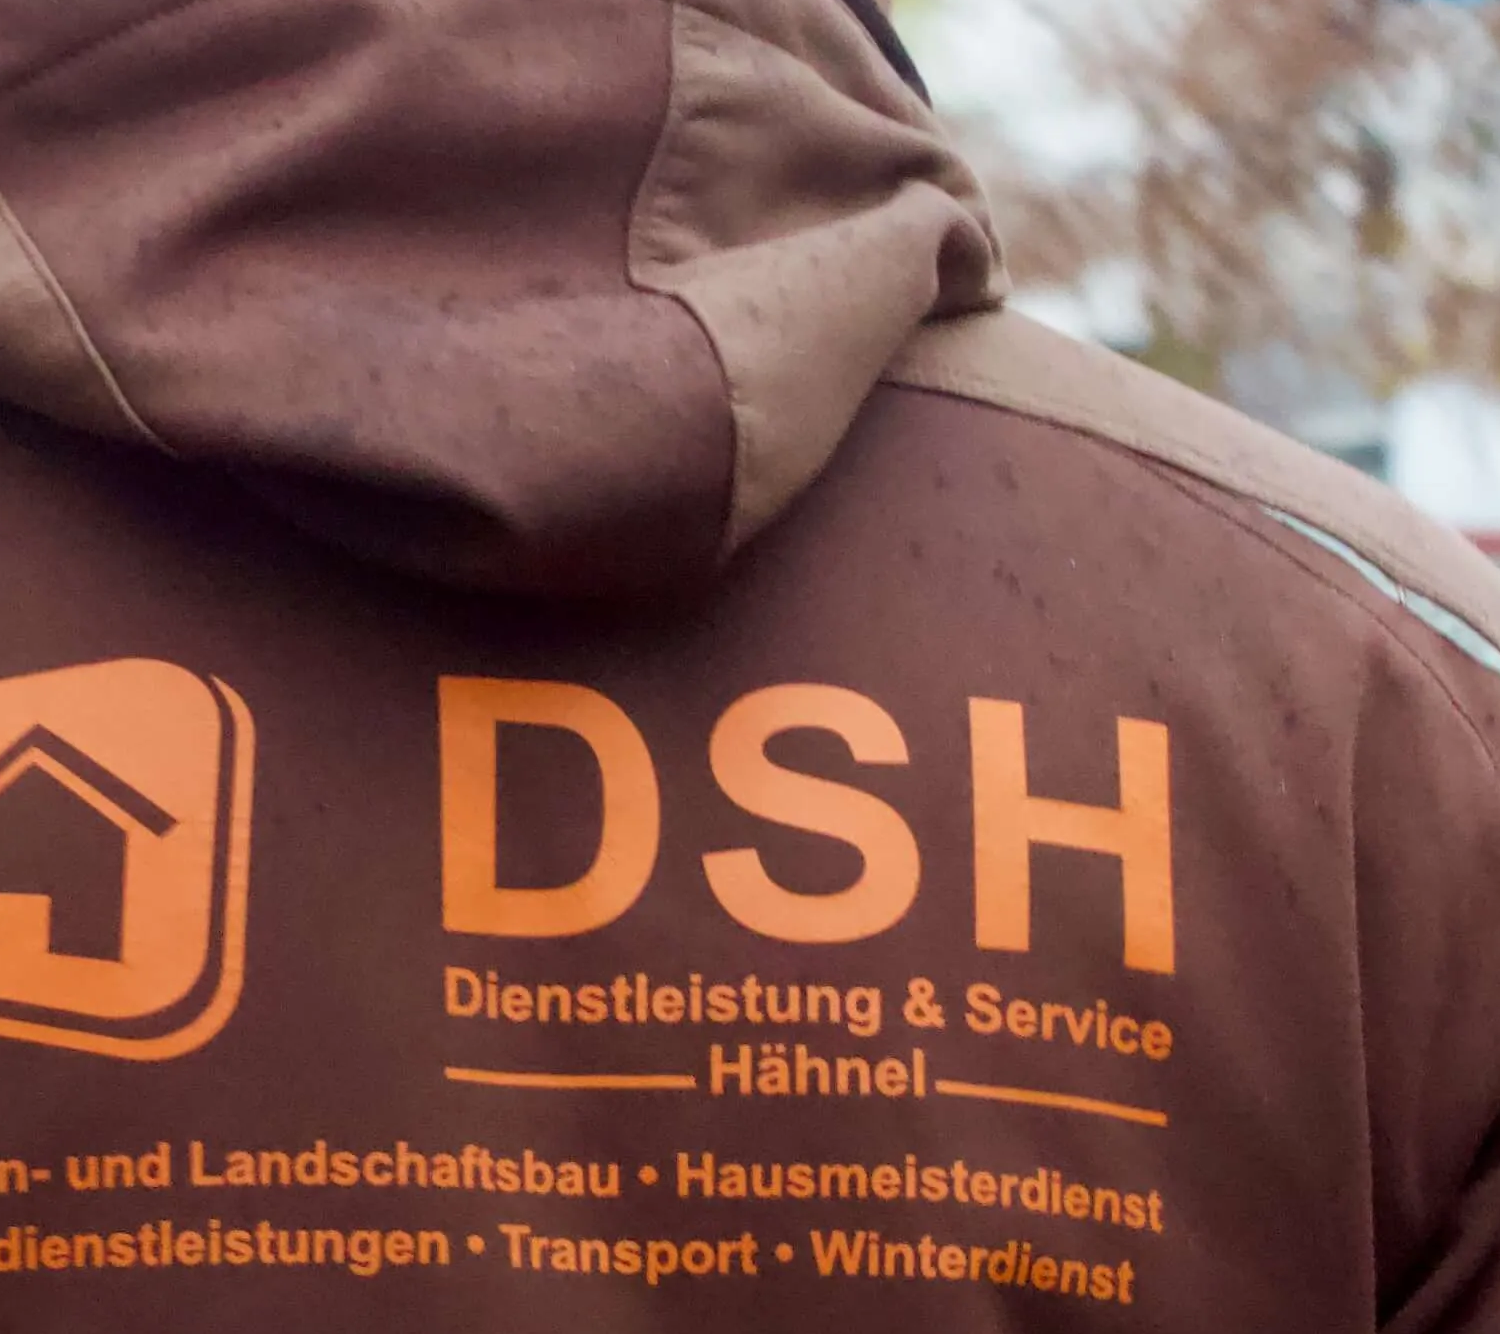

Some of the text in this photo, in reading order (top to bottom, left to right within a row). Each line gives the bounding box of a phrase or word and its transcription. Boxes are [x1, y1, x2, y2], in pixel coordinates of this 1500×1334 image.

[438, 675, 1178, 977] DSH
[443, 964, 1173, 1061] Dienstleistung & Service
[709, 1042, 928, 1100] Hähnel
[66, 1141, 172, 1192] und
[188, 1139, 620, 1198] Landschaftsbau
[676, 1151, 1165, 1235] Hausmeisterdienst
[497, 1222, 758, 1286] Transport
[809, 1229, 1135, 1305] Winterdienst
